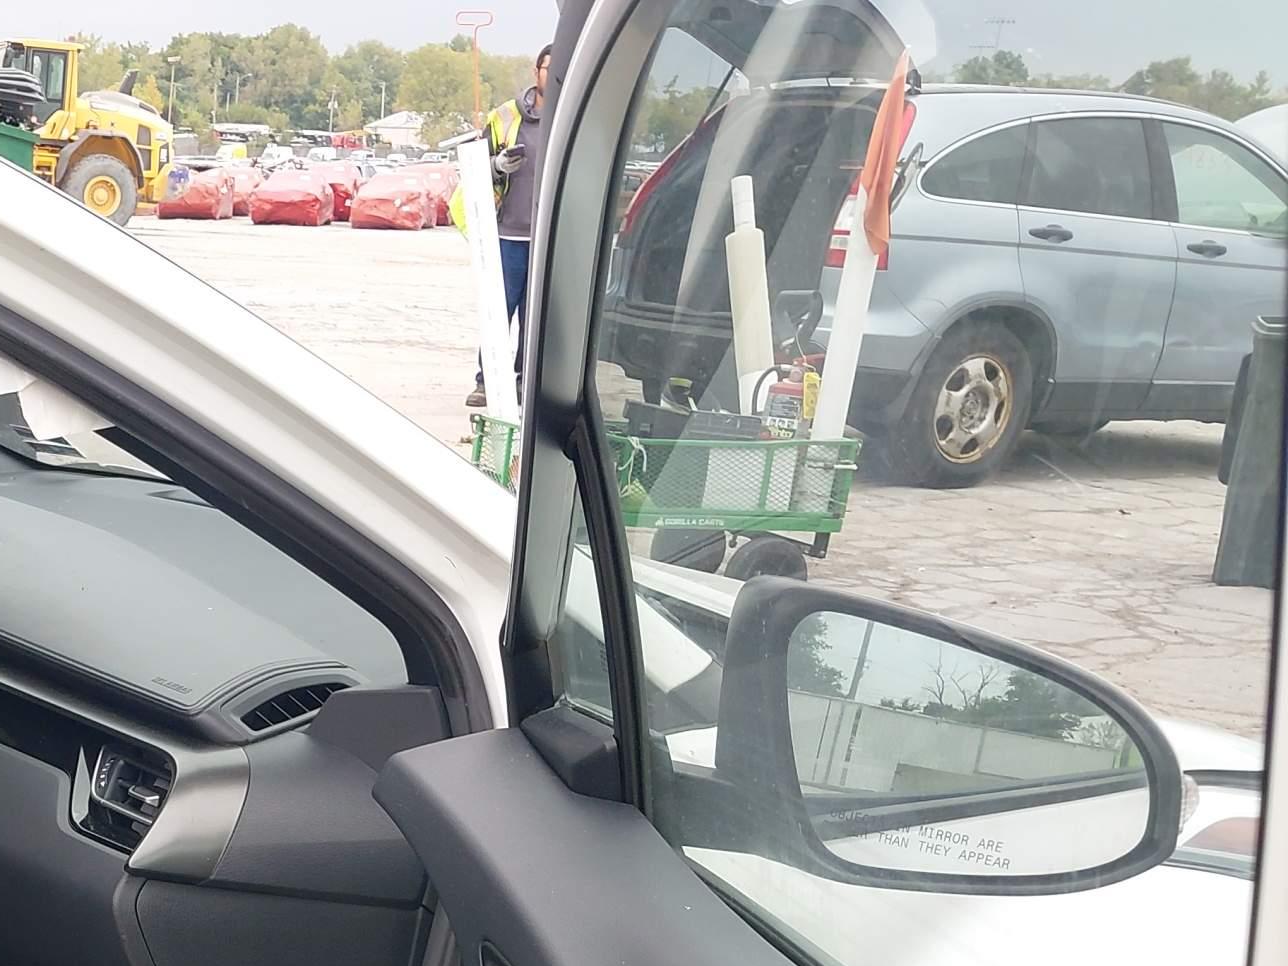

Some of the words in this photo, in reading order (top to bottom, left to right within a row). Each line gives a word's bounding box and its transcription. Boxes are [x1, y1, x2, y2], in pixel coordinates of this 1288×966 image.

[878, 832, 910, 849] THAN
[919, 840, 951, 857] THEY
[958, 849, 1011, 870] APPEAR
[919, 825, 970, 845] MIRROR
[977, 838, 1004, 853] ARE
